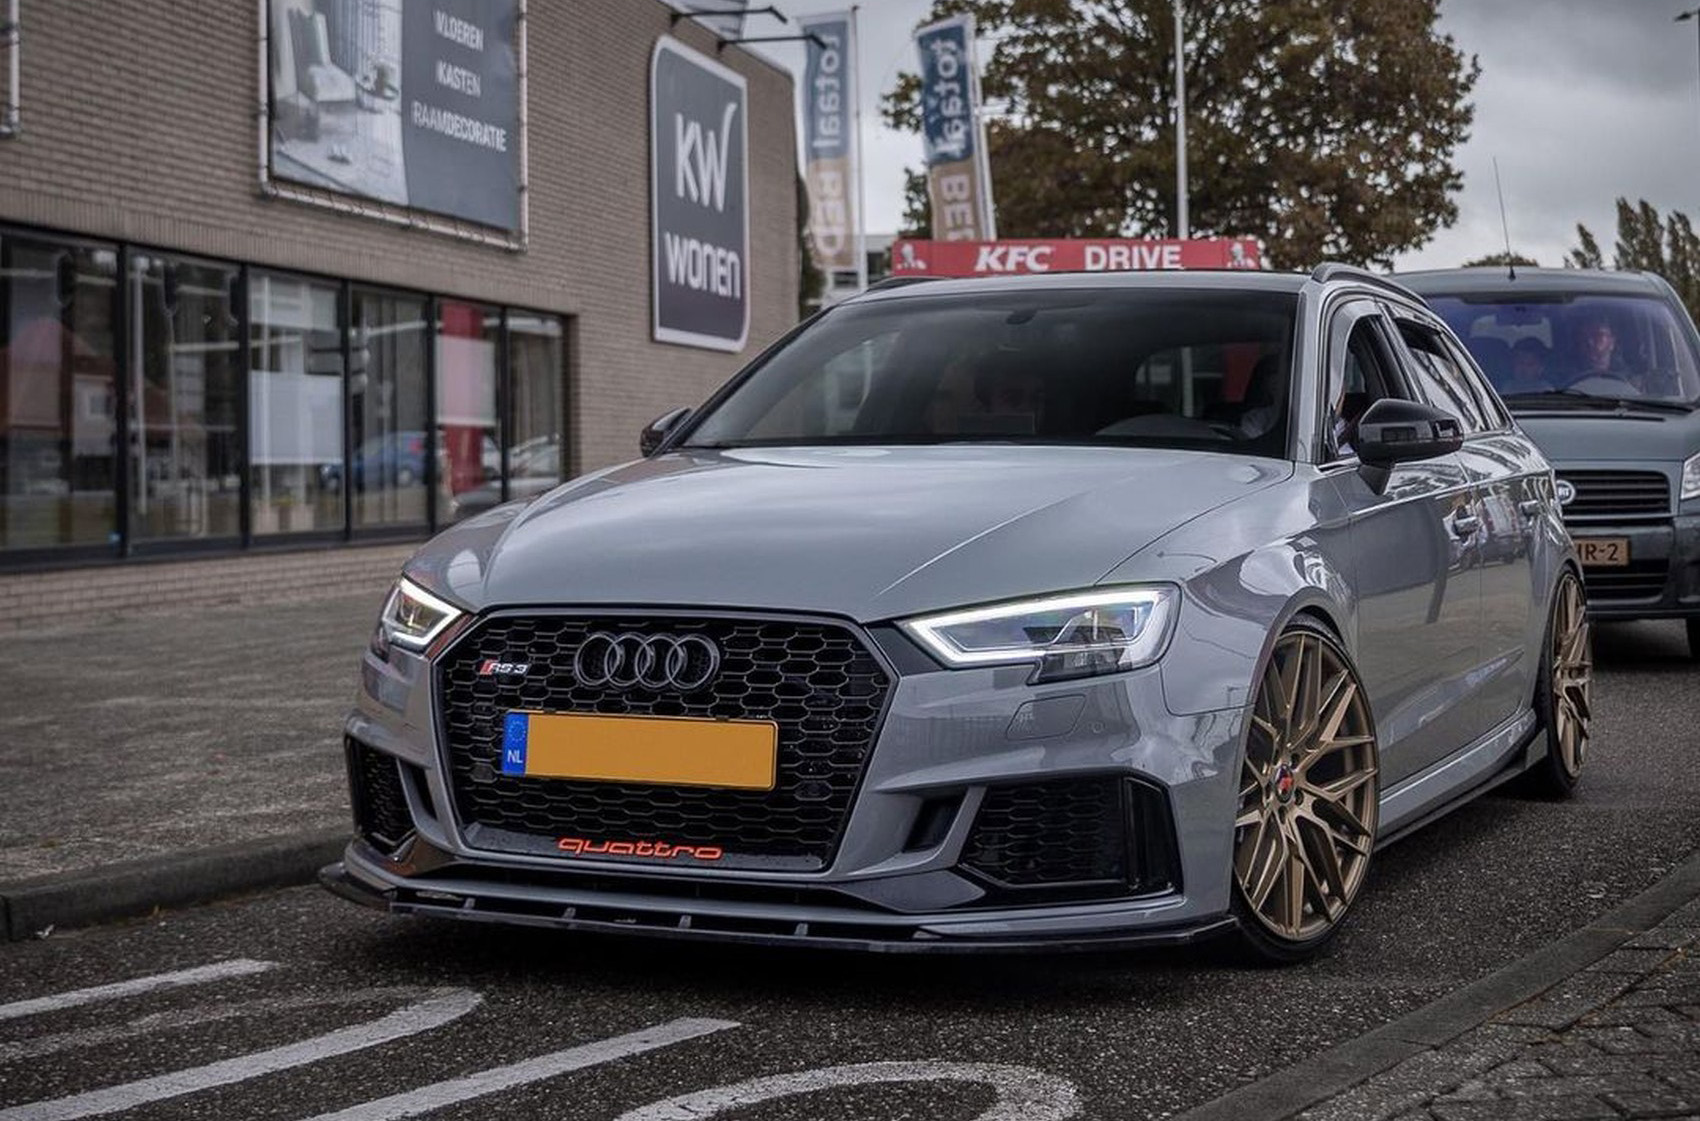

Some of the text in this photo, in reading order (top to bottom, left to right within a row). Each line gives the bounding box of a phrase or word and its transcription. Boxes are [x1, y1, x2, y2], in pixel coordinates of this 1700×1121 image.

[433, 9, 484, 52] VLOEREN
[436, 59, 481, 98] KASTEN
[411, 100, 507, 152] RAAMDECORATIE
[675, 102, 738, 212] KW
[974, 246, 1182, 272] KFC DRIVE
[507, 749, 523, 764] NL
[558, 837, 722, 860] quattro
